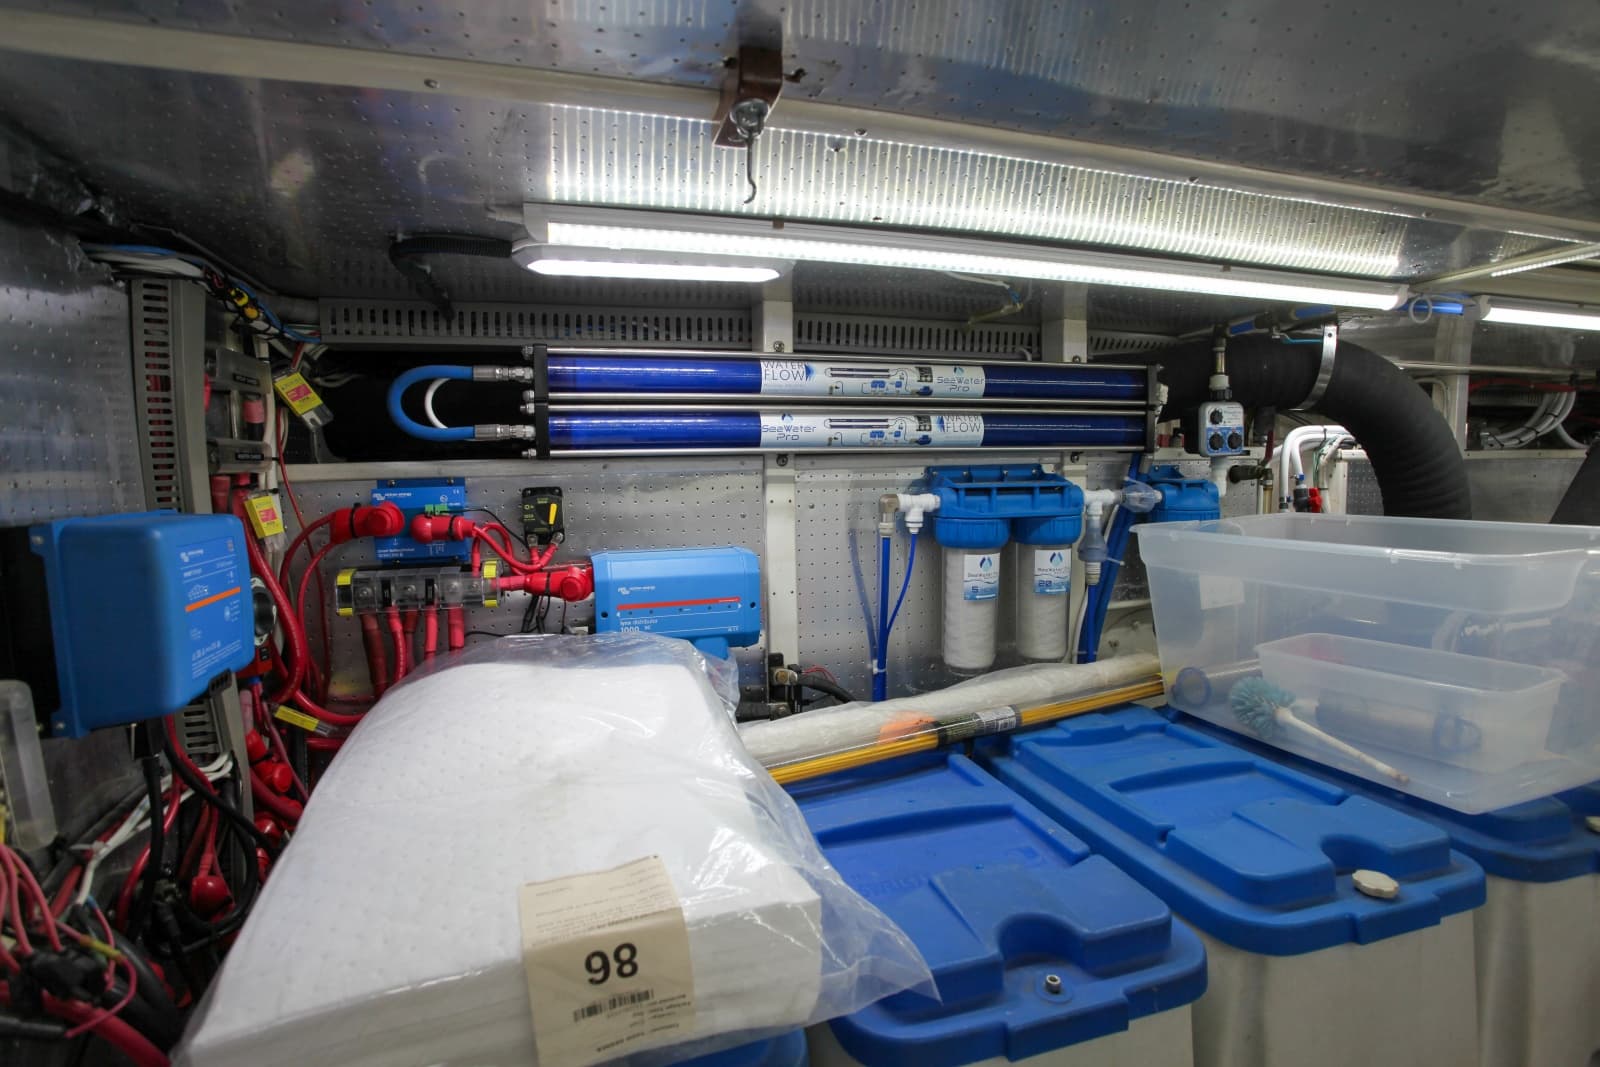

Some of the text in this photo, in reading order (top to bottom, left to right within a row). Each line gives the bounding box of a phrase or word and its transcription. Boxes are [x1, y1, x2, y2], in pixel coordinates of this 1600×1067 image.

[763, 360, 804, 369] WATER
[764, 369, 805, 381] FLOW
[937, 376, 984, 385] SeaWater
[761, 424, 816, 433] SeaWater
[946, 422, 981, 433] FLOW
[777, 433, 800, 441] Pro
